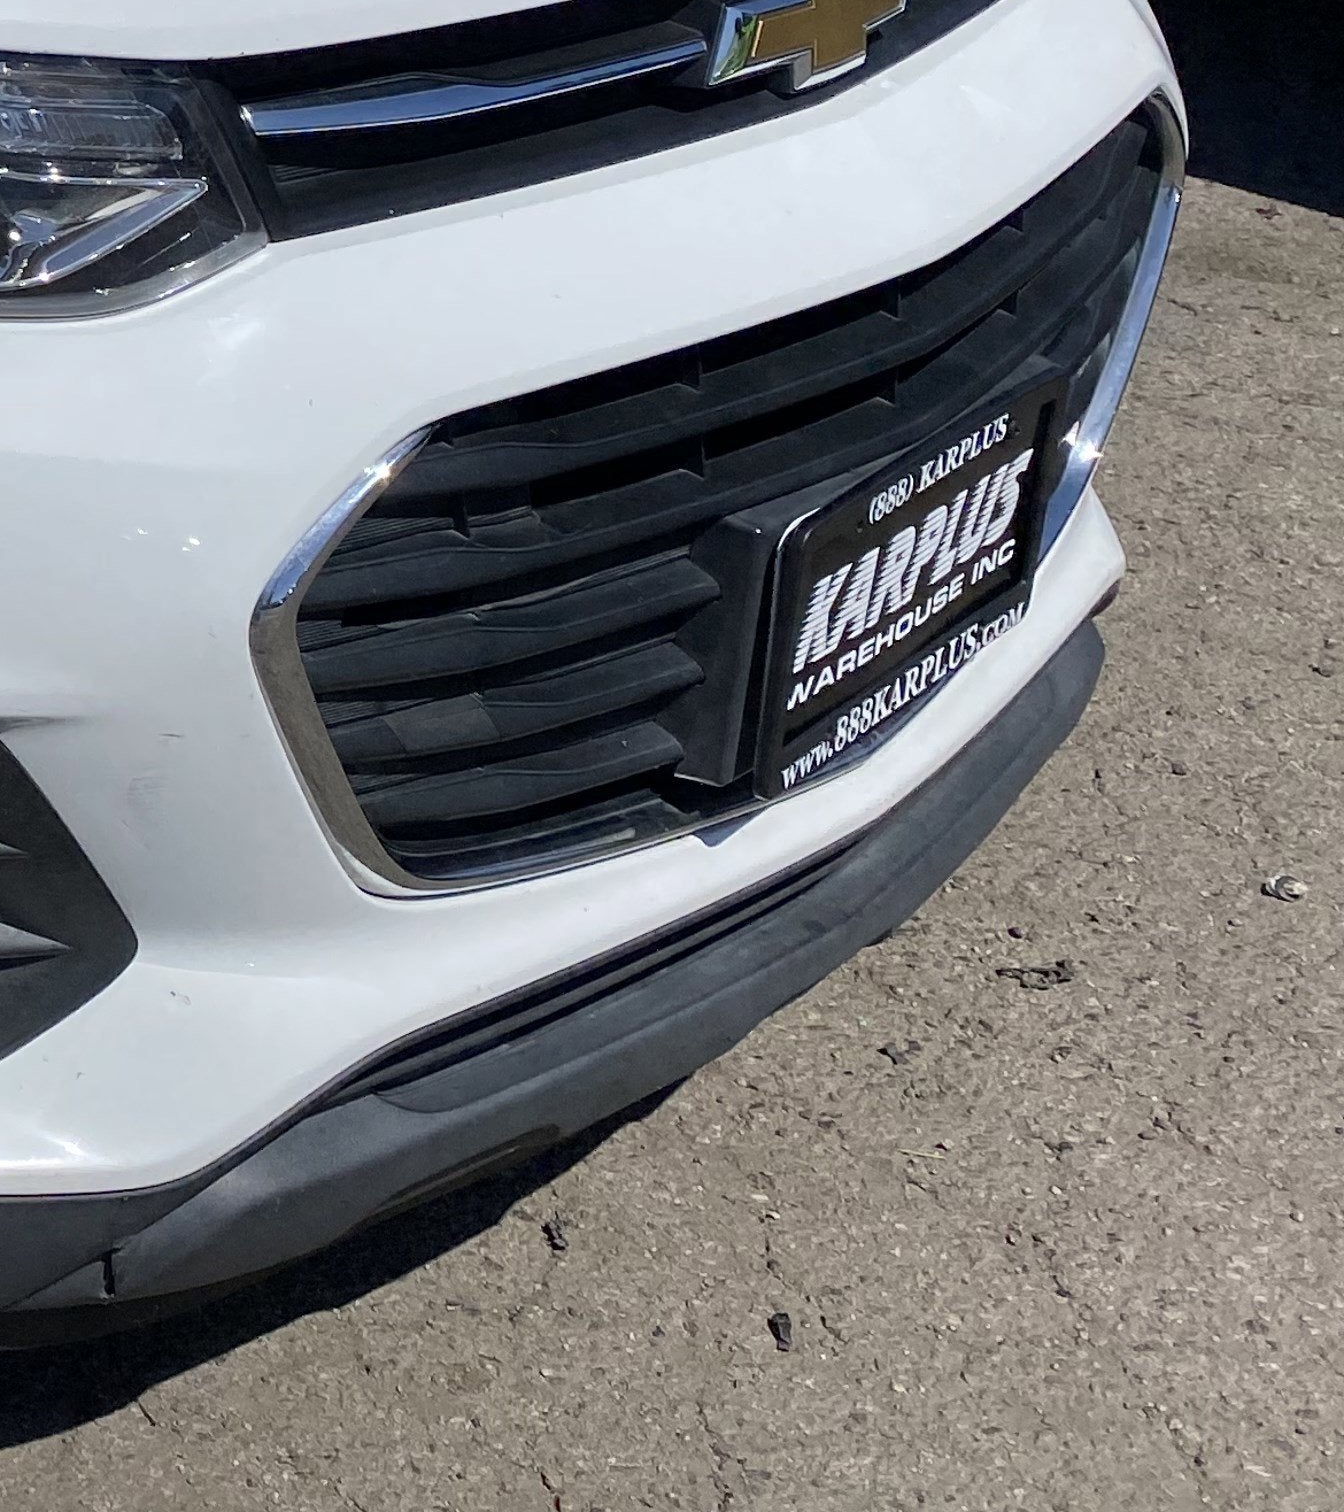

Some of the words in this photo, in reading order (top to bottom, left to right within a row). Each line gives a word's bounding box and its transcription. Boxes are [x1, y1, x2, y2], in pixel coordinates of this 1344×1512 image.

[868, 474, 914, 525] (888)
[916, 413, 1010, 494] KARPLUS
[787, 573, 965, 711] WAREHOUSE
[971, 539, 1016, 585] INC
[793, 448, 1034, 674] KARPLUS
